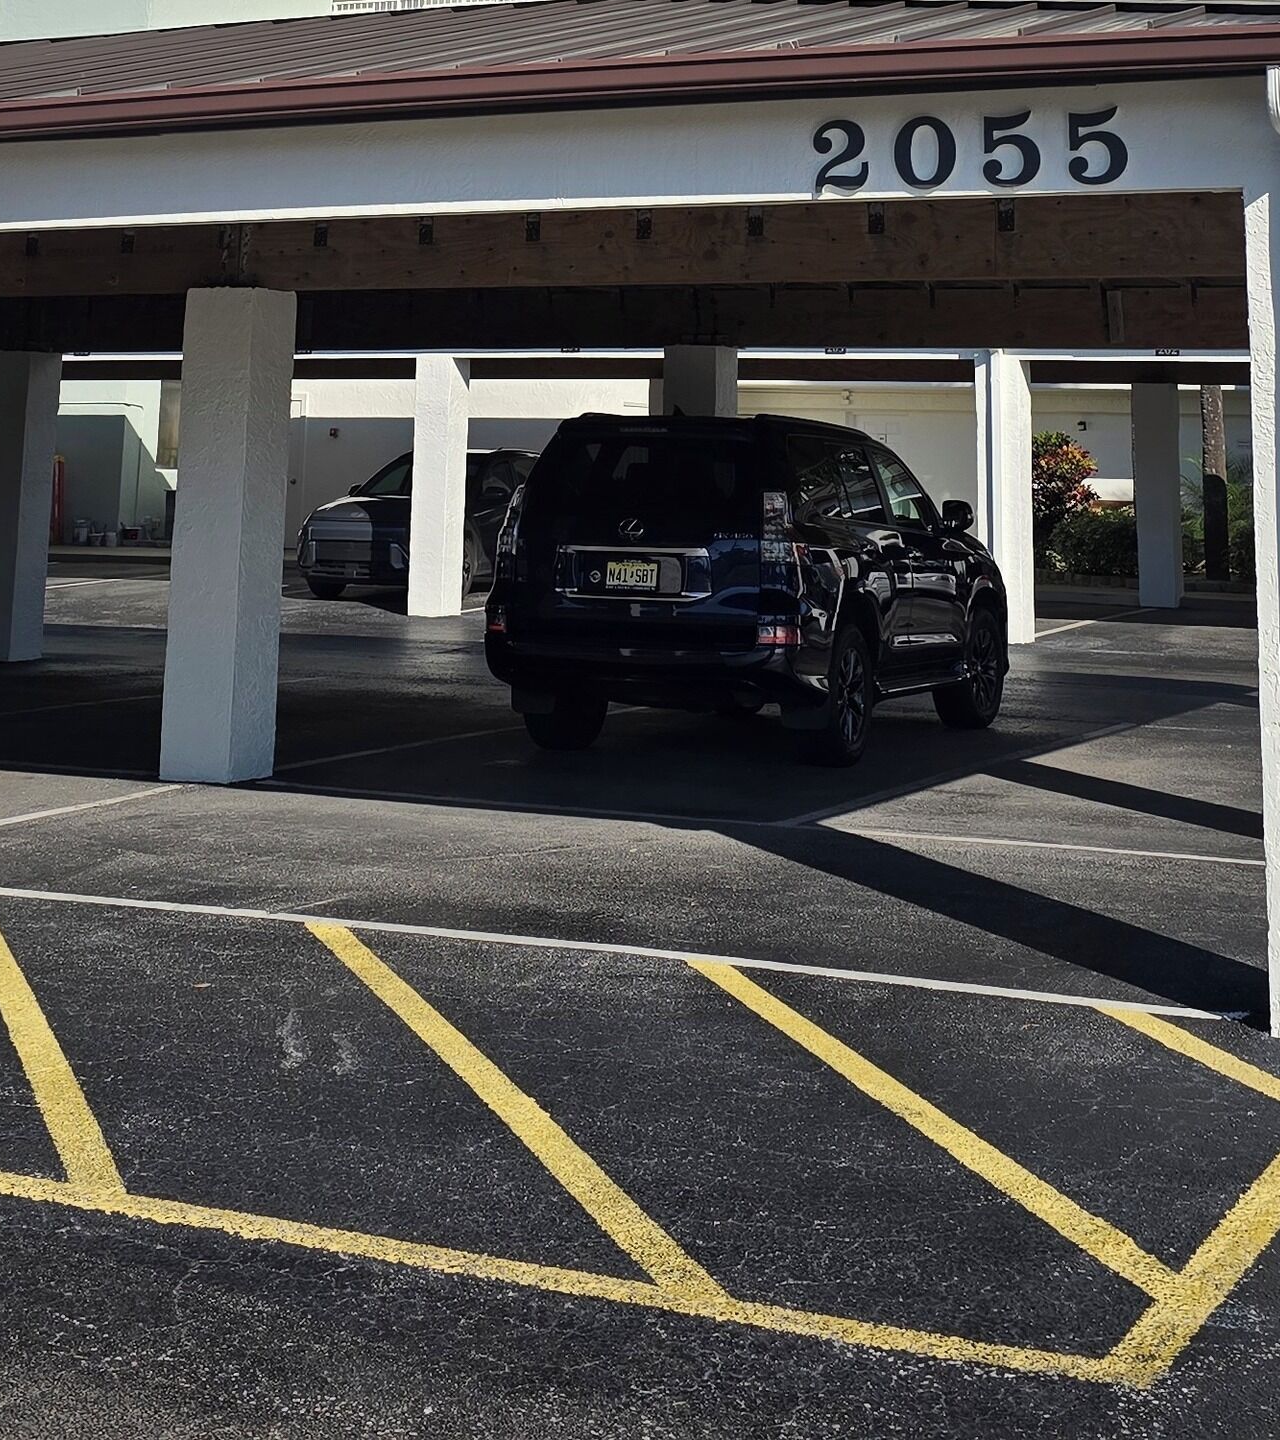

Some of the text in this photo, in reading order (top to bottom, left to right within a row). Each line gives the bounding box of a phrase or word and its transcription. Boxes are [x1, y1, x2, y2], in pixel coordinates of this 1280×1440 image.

[813, 105, 1128, 193] 2055
[608, 567, 655, 584] N41 SBT
